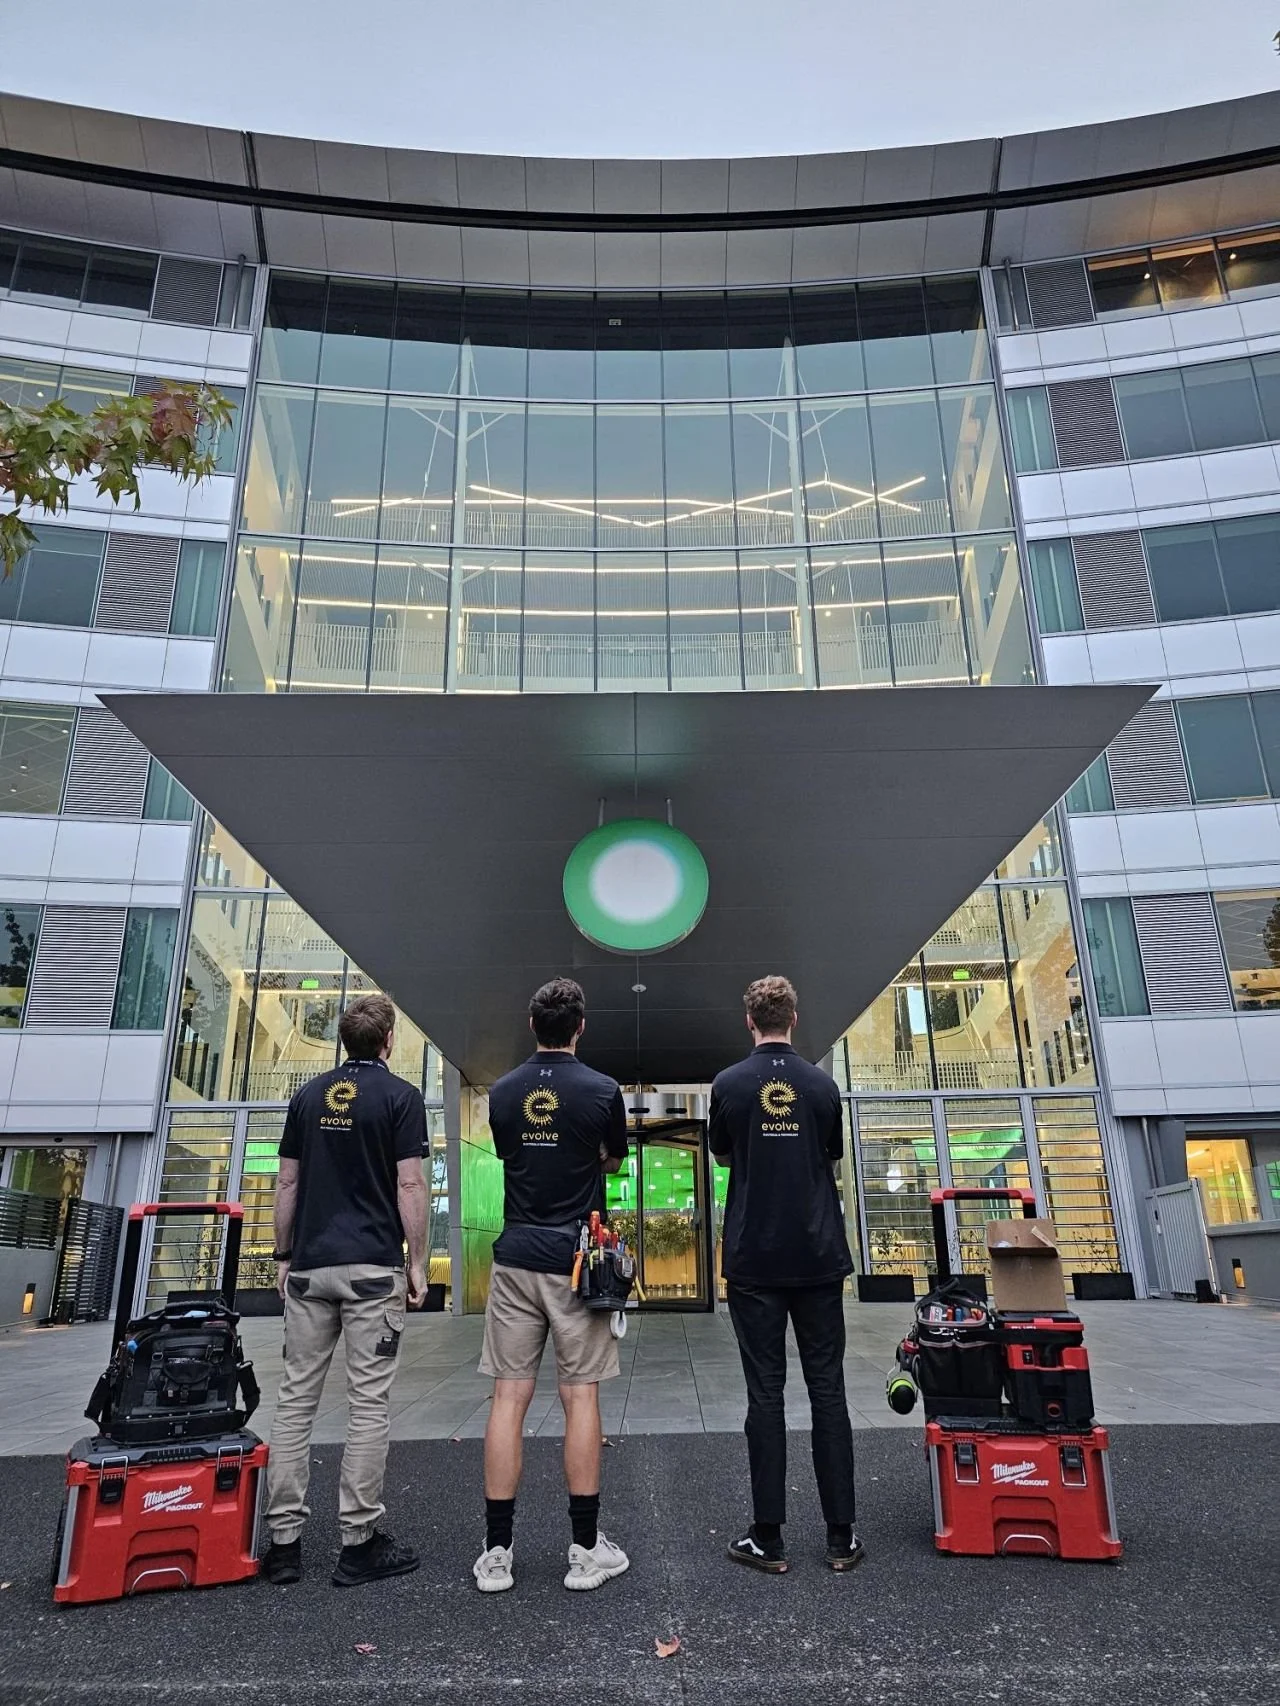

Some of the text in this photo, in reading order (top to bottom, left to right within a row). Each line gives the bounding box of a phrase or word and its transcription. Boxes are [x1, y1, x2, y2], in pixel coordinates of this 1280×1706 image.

[320, 1116, 353, 1126] evolve
[761, 1121, 800, 1131] evolve
[521, 1130, 559, 1141] evolve
[990, 1460, 1036, 1480] Milwaukee
[142, 1485, 193, 1508] Milwaukee
[165, 1502, 204, 1512] PACKOUT
